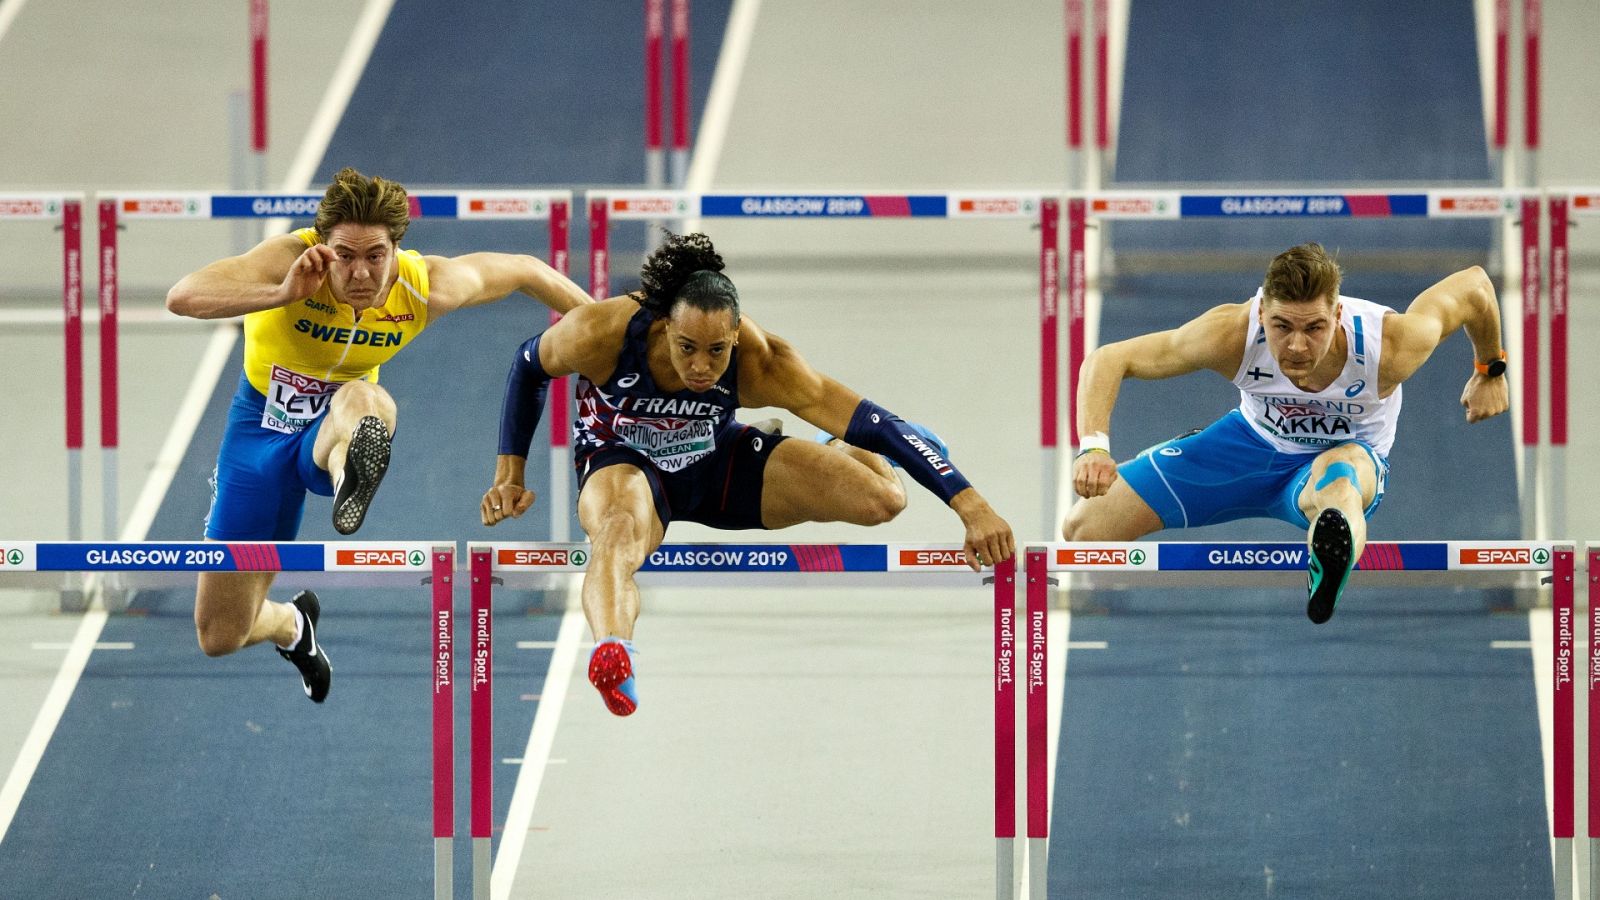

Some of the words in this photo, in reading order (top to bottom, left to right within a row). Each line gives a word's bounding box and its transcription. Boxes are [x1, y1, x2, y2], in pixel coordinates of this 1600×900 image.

[252, 199, 323, 214] GLASGO
[741, 198, 825, 214] GLASGOW
[1220, 198, 1304, 214] GLASGOW
[294, 319, 402, 347] SWEDEN
[275, 384, 334, 414] LEV
[632, 398, 724, 417] FRANCE
[1265, 403, 1351, 435] LAKKA
[661, 444, 692, 456] CLEAN
[902, 434, 949, 470] FRANCE
[86, 550, 181, 565] GLASGOW
[185, 550, 225, 565] 2019
[353, 551, 406, 565] SPAR
[514, 551, 568, 565] SPAR
[649, 551, 743, 566] GLASGOW
[748, 551, 788, 566] 2019
[1073, 551, 1126, 564] SPAR
[1208, 550, 1303, 565] GLASGOW
[1476, 550, 1530, 563] SPAR
